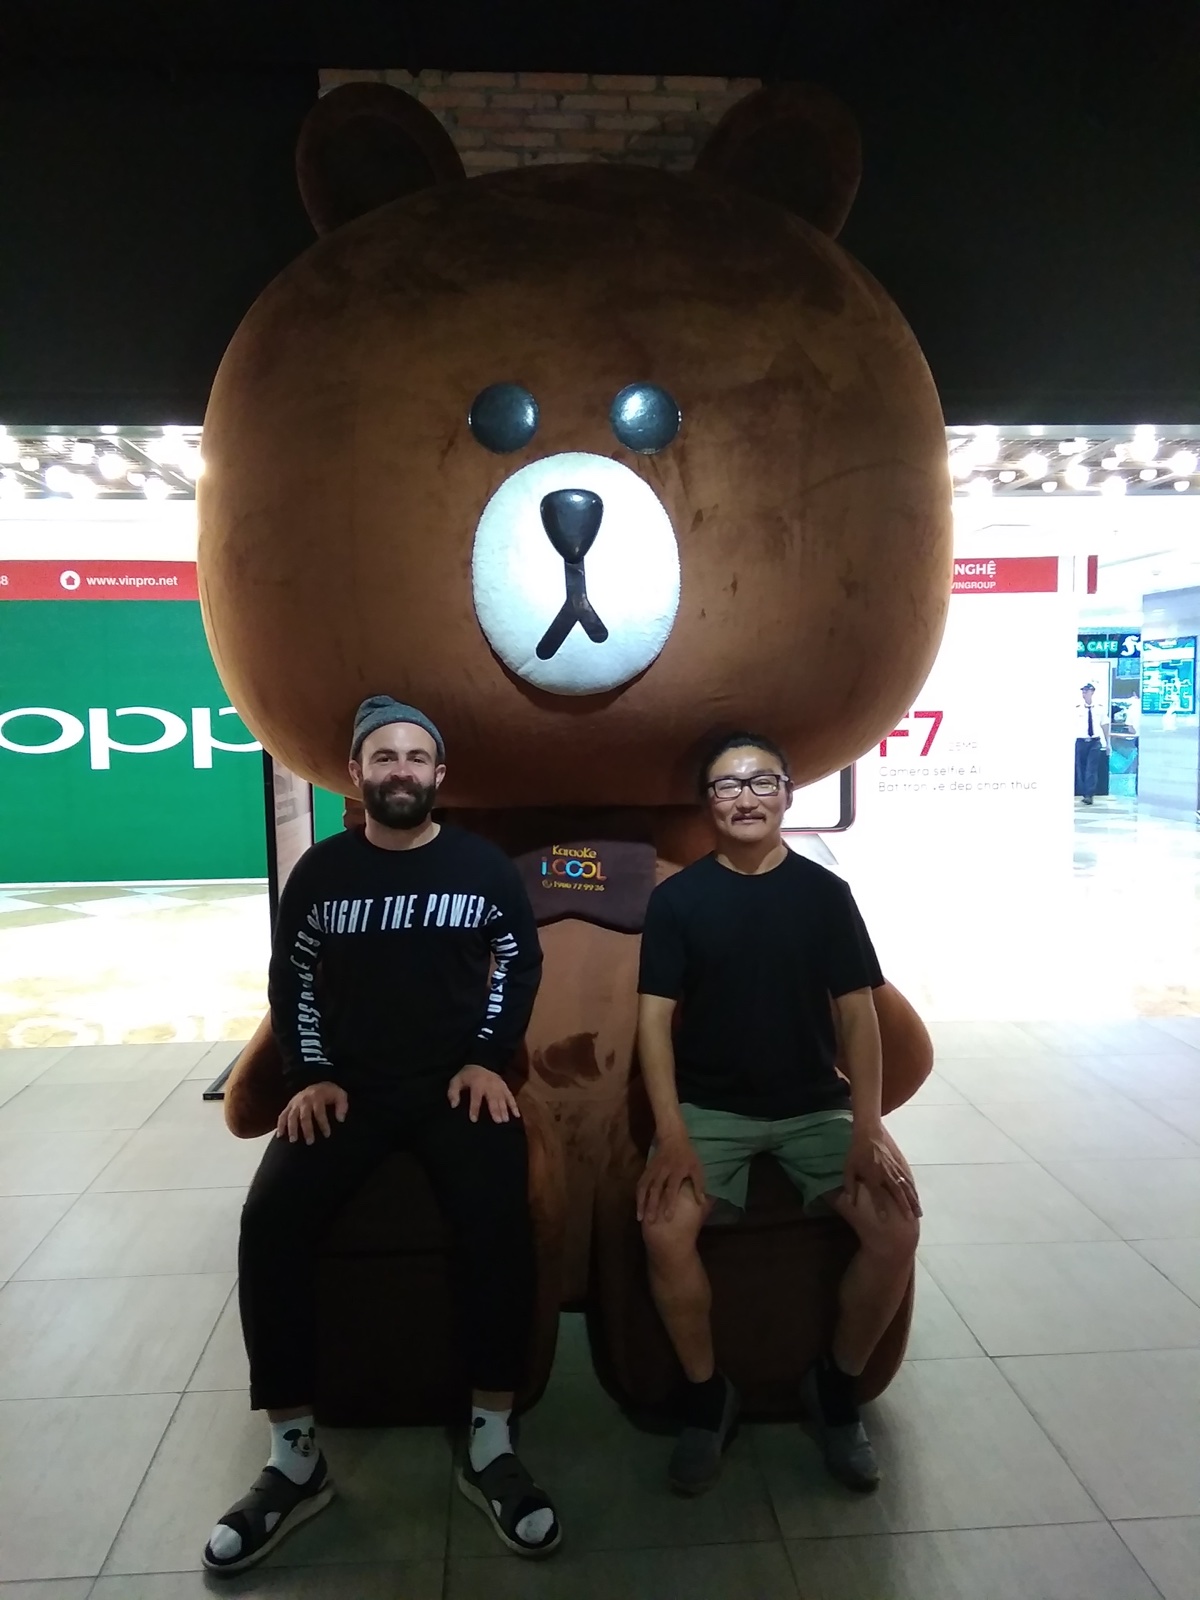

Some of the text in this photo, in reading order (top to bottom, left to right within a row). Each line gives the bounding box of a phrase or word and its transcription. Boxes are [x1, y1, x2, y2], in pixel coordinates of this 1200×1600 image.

[954, 560, 996, 578] NGHỆ
[86, 575, 179, 587] www.vinpro.net
[879, 766, 930, 777] Camera
[323, 894, 485, 933] FIGHT THE POWER
